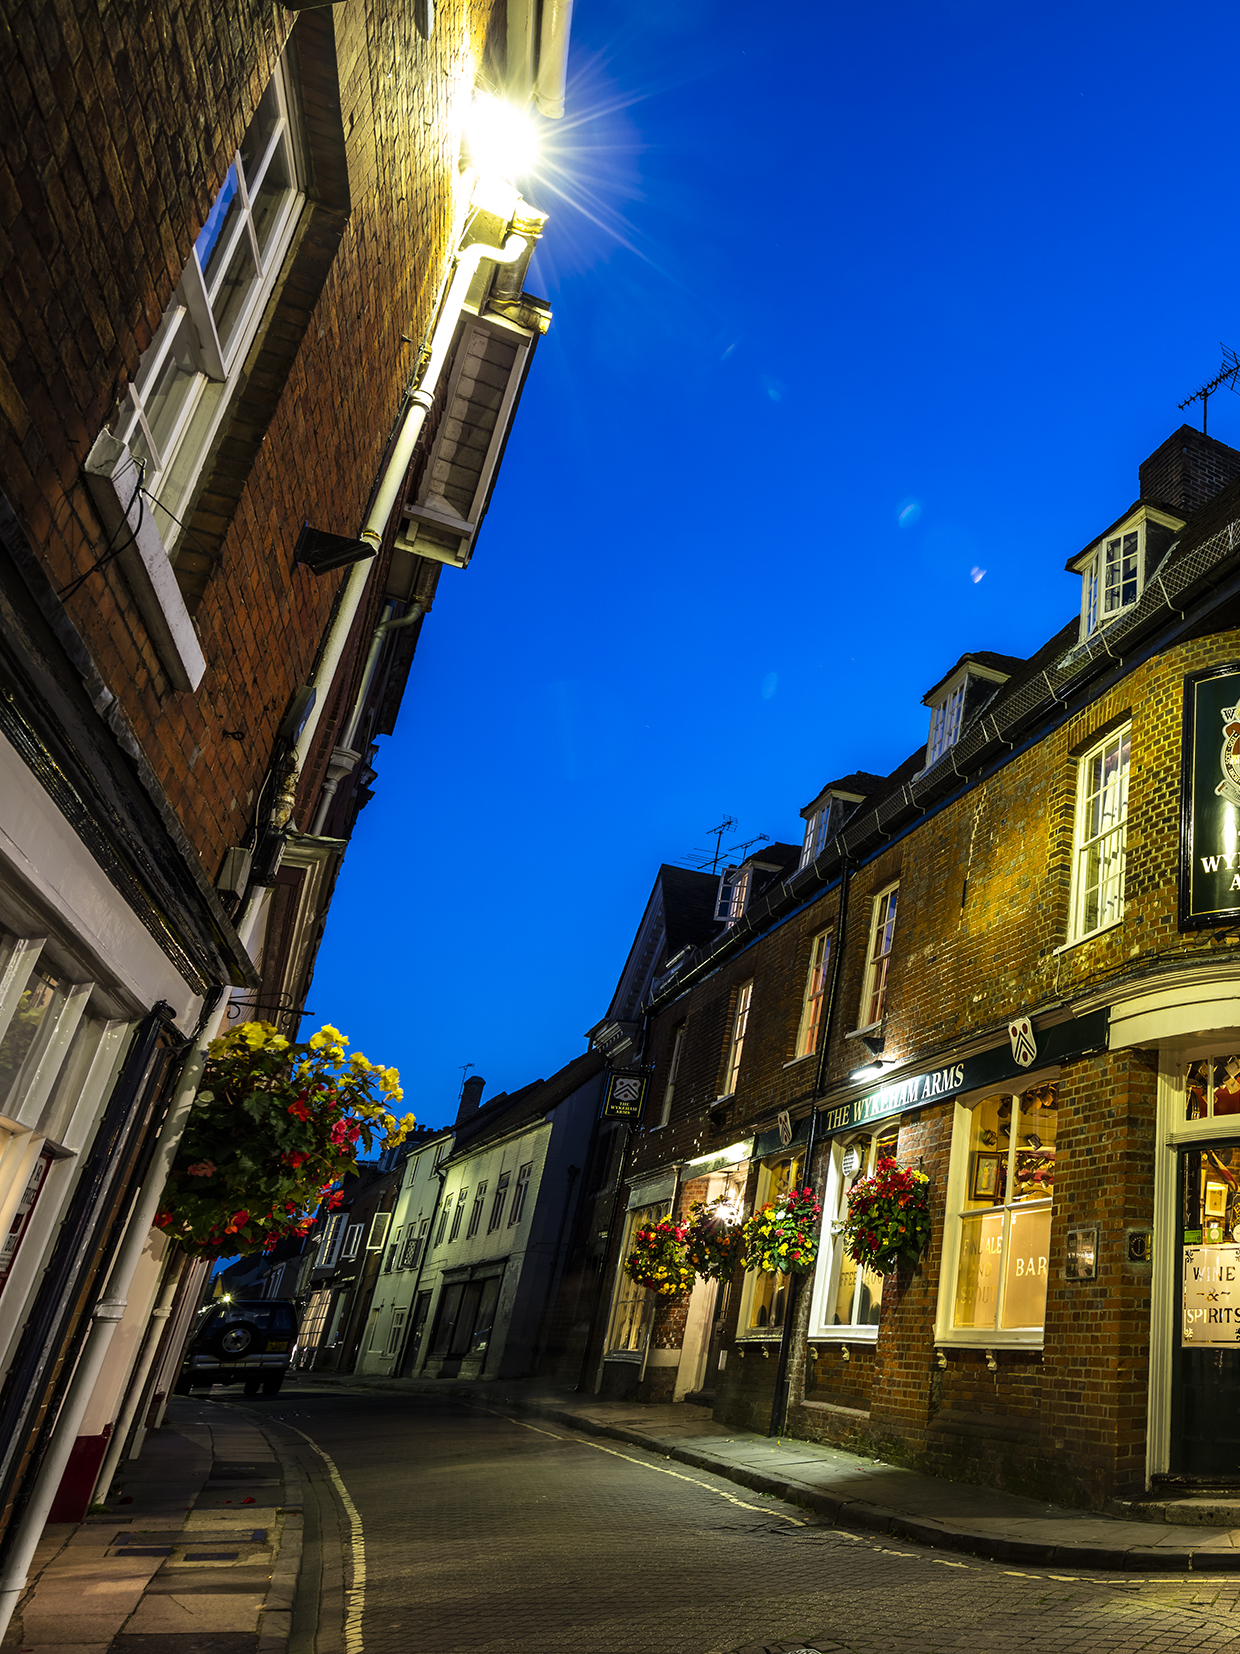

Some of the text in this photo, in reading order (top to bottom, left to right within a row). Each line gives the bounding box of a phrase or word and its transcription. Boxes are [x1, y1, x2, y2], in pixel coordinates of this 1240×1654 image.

[1223, 708, 1236, 720] W
[827, 1063, 964, 1131] THE WYKEHAM ARMS
[963, 1236, 1003, 1256] FNE ALE
[968, 1262, 993, 1278] AND
[1015, 1256, 1048, 1276] BAR
[1193, 1266, 1236, 1282] WINE
[840, 1271, 857, 1286] FFEE
